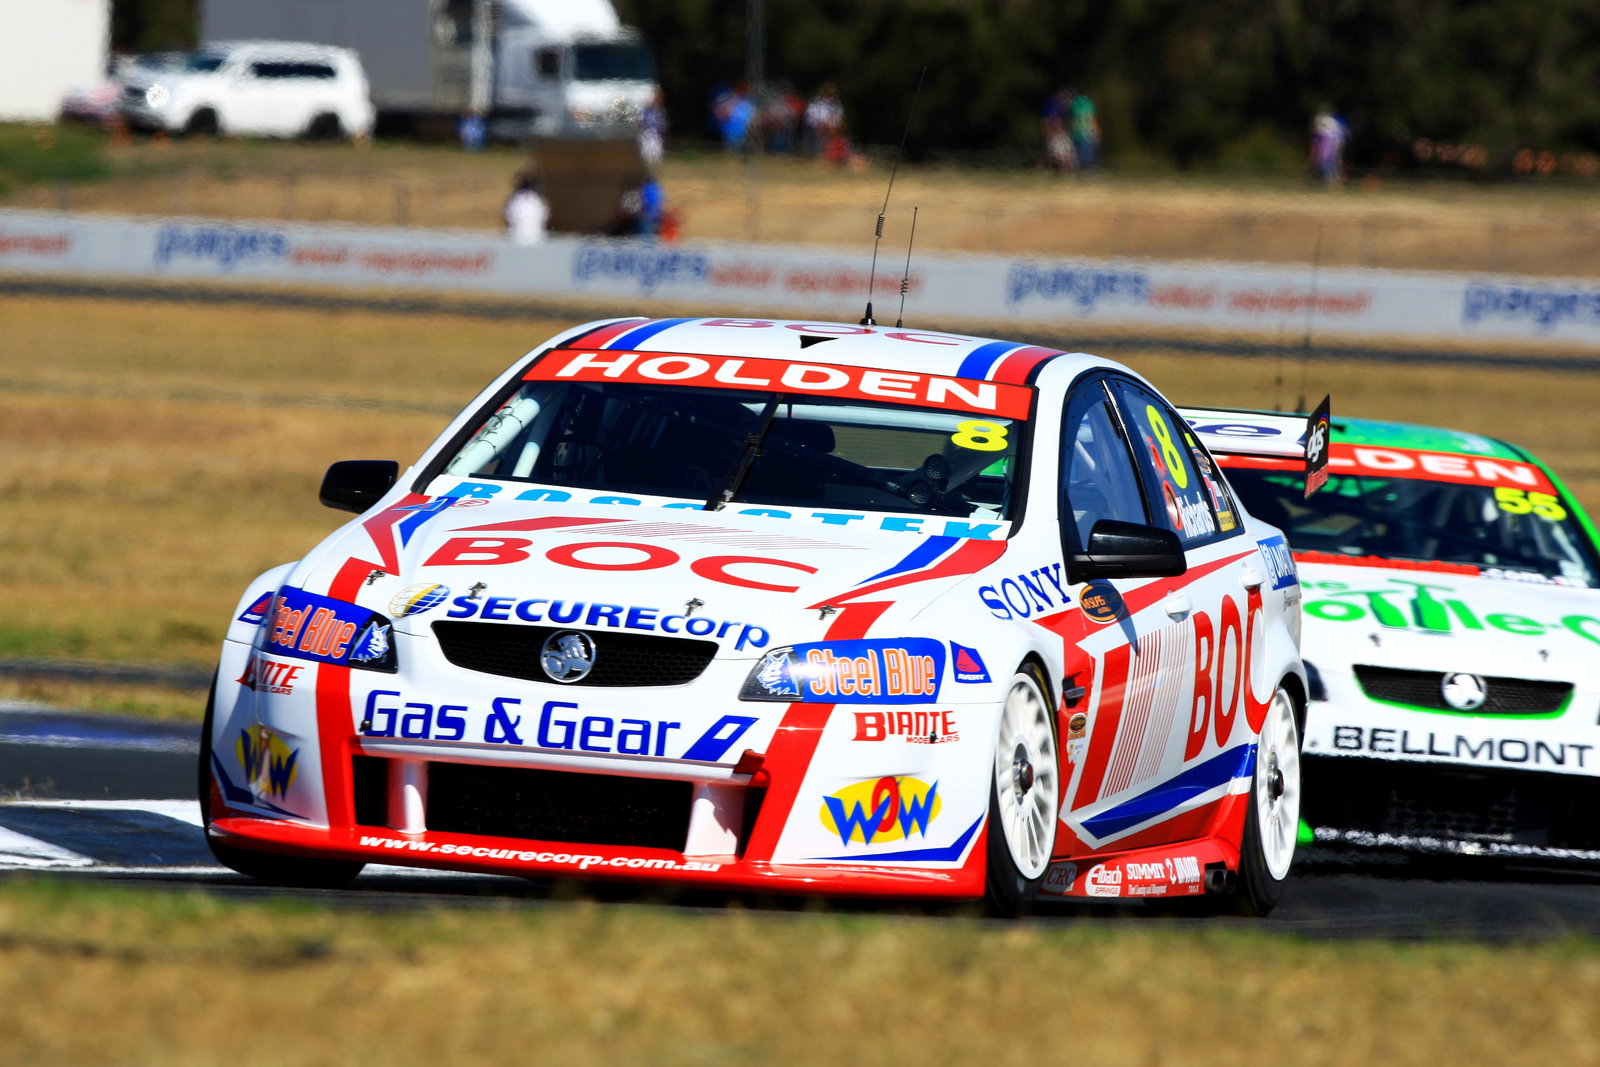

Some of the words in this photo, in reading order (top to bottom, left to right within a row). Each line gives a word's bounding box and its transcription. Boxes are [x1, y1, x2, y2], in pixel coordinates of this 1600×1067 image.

[702, 318, 972, 346] BOC
[556, 352, 997, 411] HOLDEN
[952, 419, 1008, 451] 8
[1146, 404, 1188, 489] 8
[1494, 487, 1567, 521] 55
[422, 537, 818, 592] BOC
[978, 563, 1071, 620] SONY
[298, 606, 356, 659] Blue
[446, 595, 769, 651] SECUREcorp
[808, 648, 881, 696] Steel
[882, 648, 936, 696] Blue
[1184, 594, 1276, 763] BOC
[364, 690, 468, 741] Gas
[484, 697, 524, 745] &
[537, 701, 680, 757] Gear
[851, 710, 959, 741] BIANTE
[1333, 725, 1594, 767] BELLMONT
[822, 776, 939, 848] WOW
[359, 835, 722, 872] www.securecorp.com.au
[1126, 863, 1165, 880] SUMMIT
